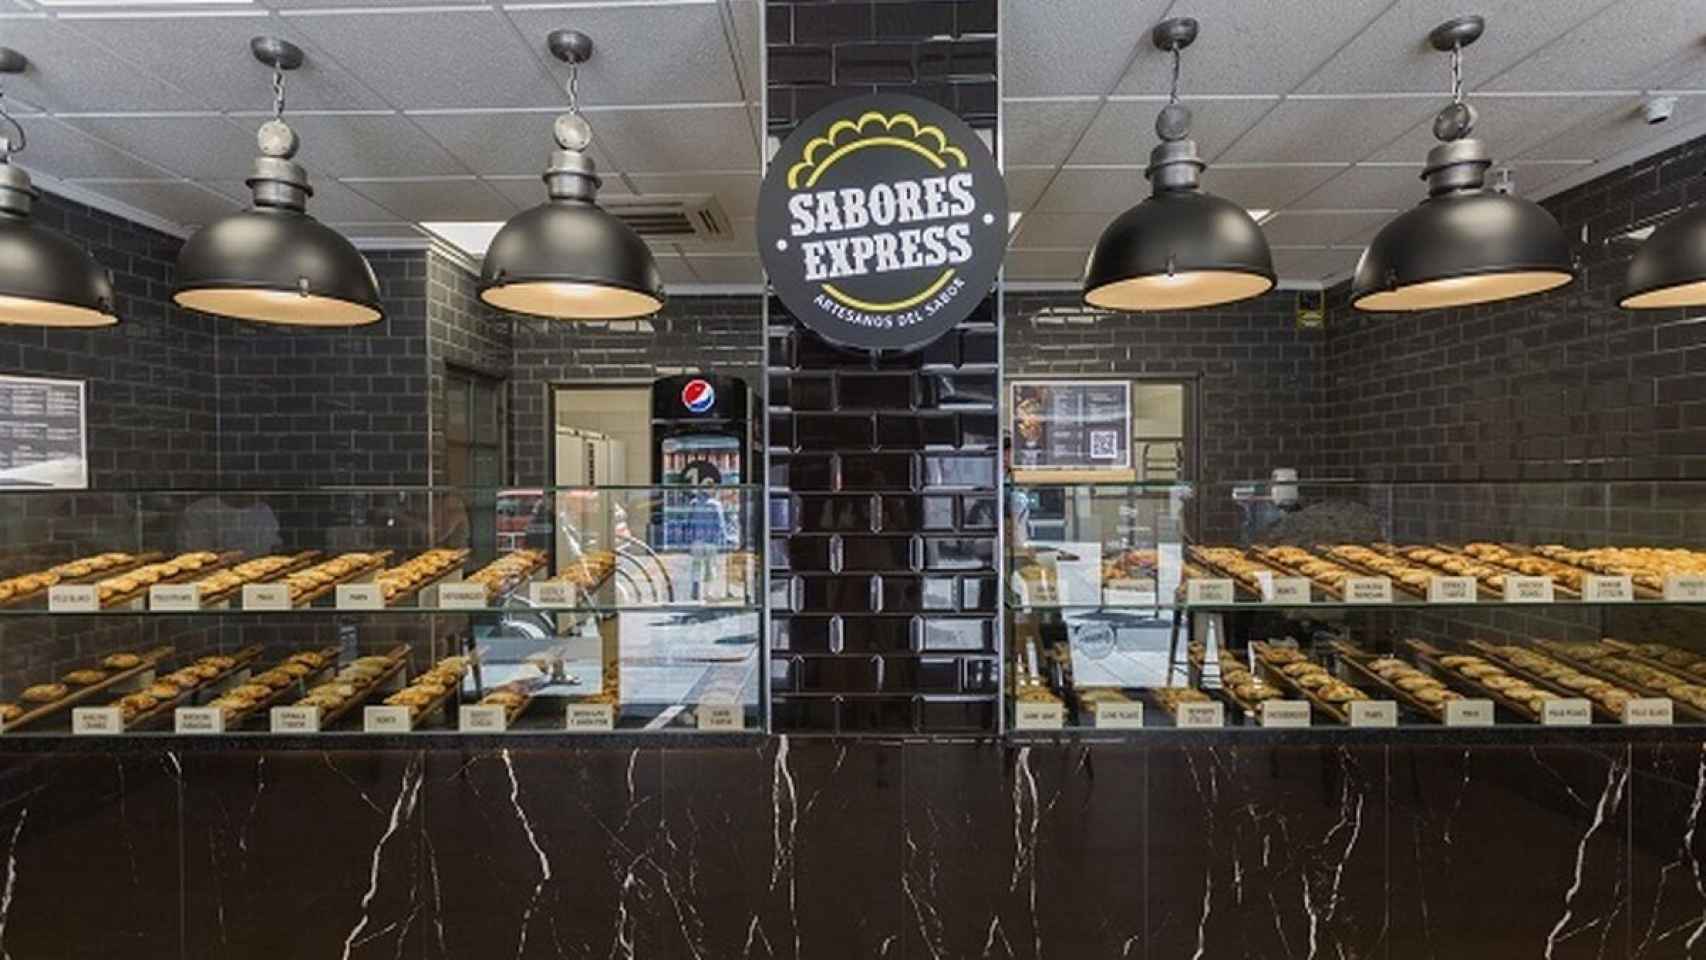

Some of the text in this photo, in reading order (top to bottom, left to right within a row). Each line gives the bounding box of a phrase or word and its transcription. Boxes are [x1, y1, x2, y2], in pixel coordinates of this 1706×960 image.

[788, 172, 976, 237] SABORES
[802, 222, 973, 282] EXPRESS
[813, 277, 966, 329] ARTESANOS DEL SABOR
